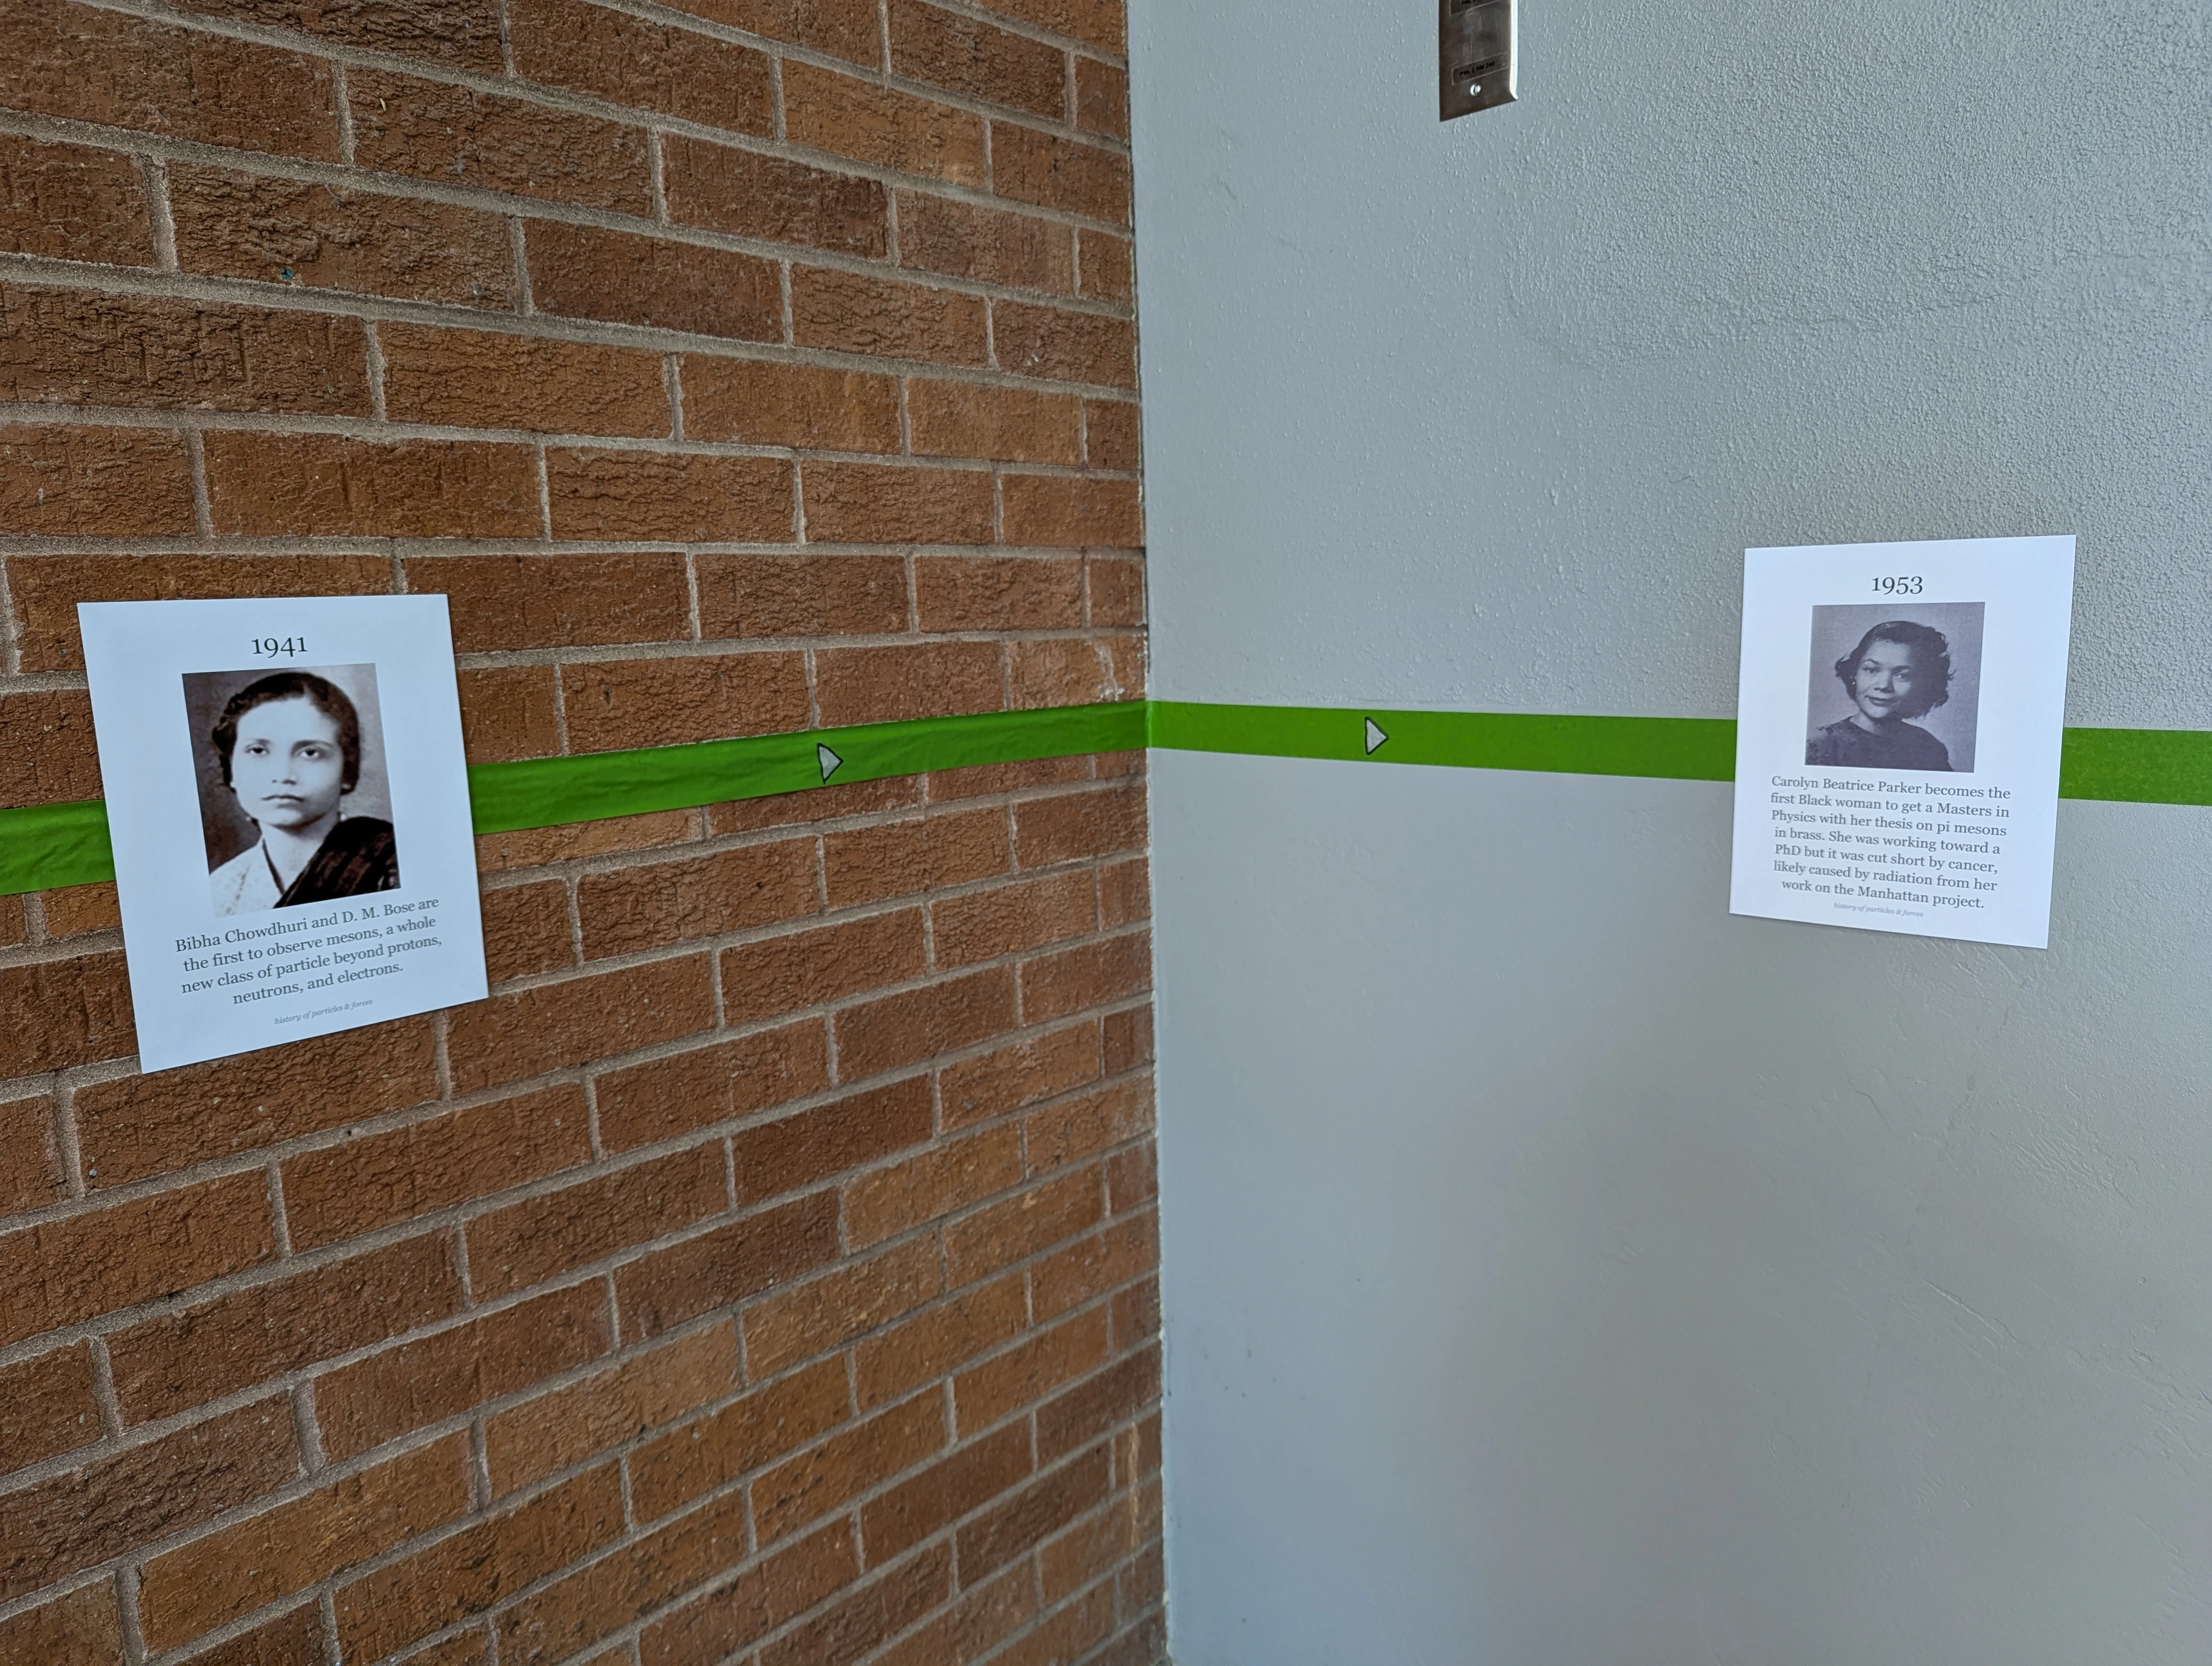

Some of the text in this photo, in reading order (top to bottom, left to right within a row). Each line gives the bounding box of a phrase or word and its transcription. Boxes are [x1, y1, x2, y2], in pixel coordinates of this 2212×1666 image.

[1872, 576, 1923, 595] 1953
[251, 637, 308, 659] 1941
[1771, 776, 2011, 799] Carolyn Beatrice Parker becomes the
[1770, 792, 2010, 818] first Black woman to get a Masters in
[1771, 809, 2007, 836] Physics with her thesis on pi mesons
[1774, 826, 2001, 855] in brass. She was working toward a
[1774, 843, 1998, 875] PhD but it was cut short by cancer,
[1773, 860, 1998, 891] likely caused by radiation from her
[1781, 880, 1985, 909] work on the Manhattan project.
[1834, 902, 1857, 911] history
[175, 899, 439, 952] Bibha Chowdhuri and D. M. Bose are
[183, 916, 436, 972] the first to observe mesons, a whole
[181, 937, 442, 994] new class of particle beyond protons,
[232, 963, 403, 1005] neutrons, and electrons.
[274, 1015, 301, 1024] history
[303, 1010, 312, 1020] of
[311, 1005, 343, 1018] particles
[351, 999, 373, 1010] forces
